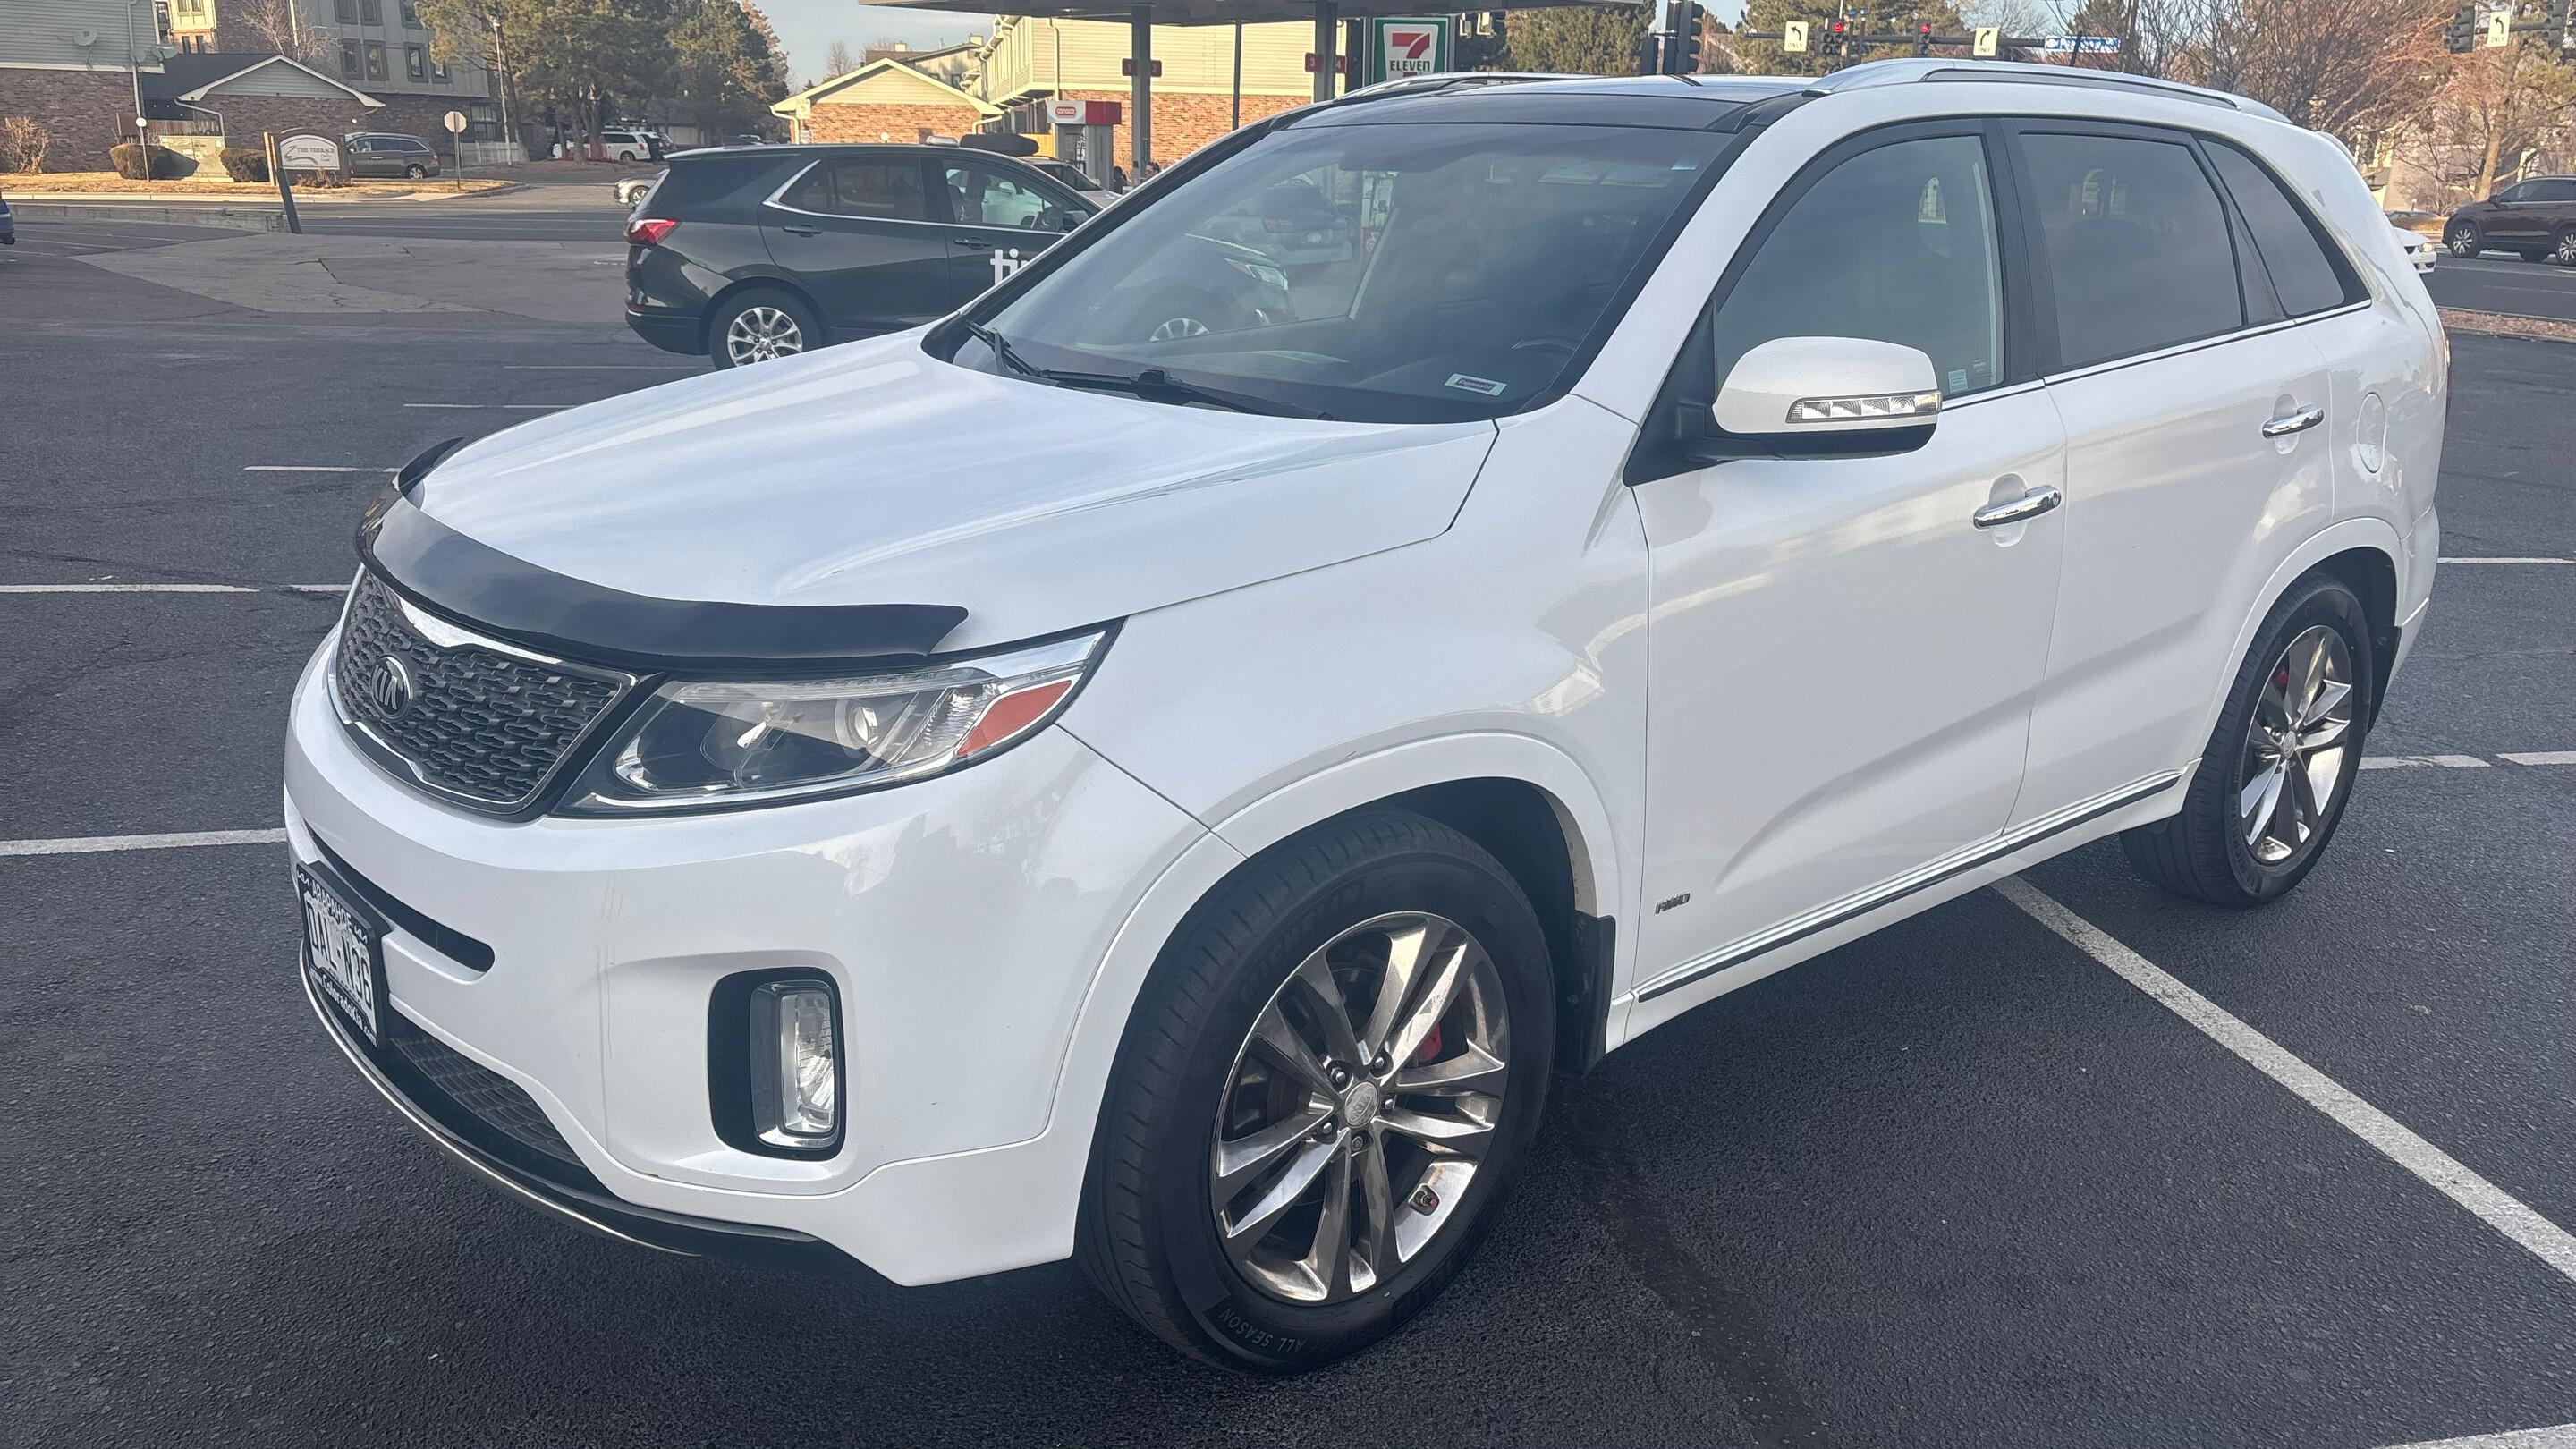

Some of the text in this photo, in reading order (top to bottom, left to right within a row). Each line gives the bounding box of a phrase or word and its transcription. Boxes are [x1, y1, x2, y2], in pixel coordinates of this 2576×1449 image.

[1392, 32, 1430, 61] 7
[371, 665, 398, 710] KIA
[311, 879, 352, 931] ARAPAHOE
[1217, 1308, 1274, 1347] SEASON
[1277, 1336, 1307, 1353] ALL
